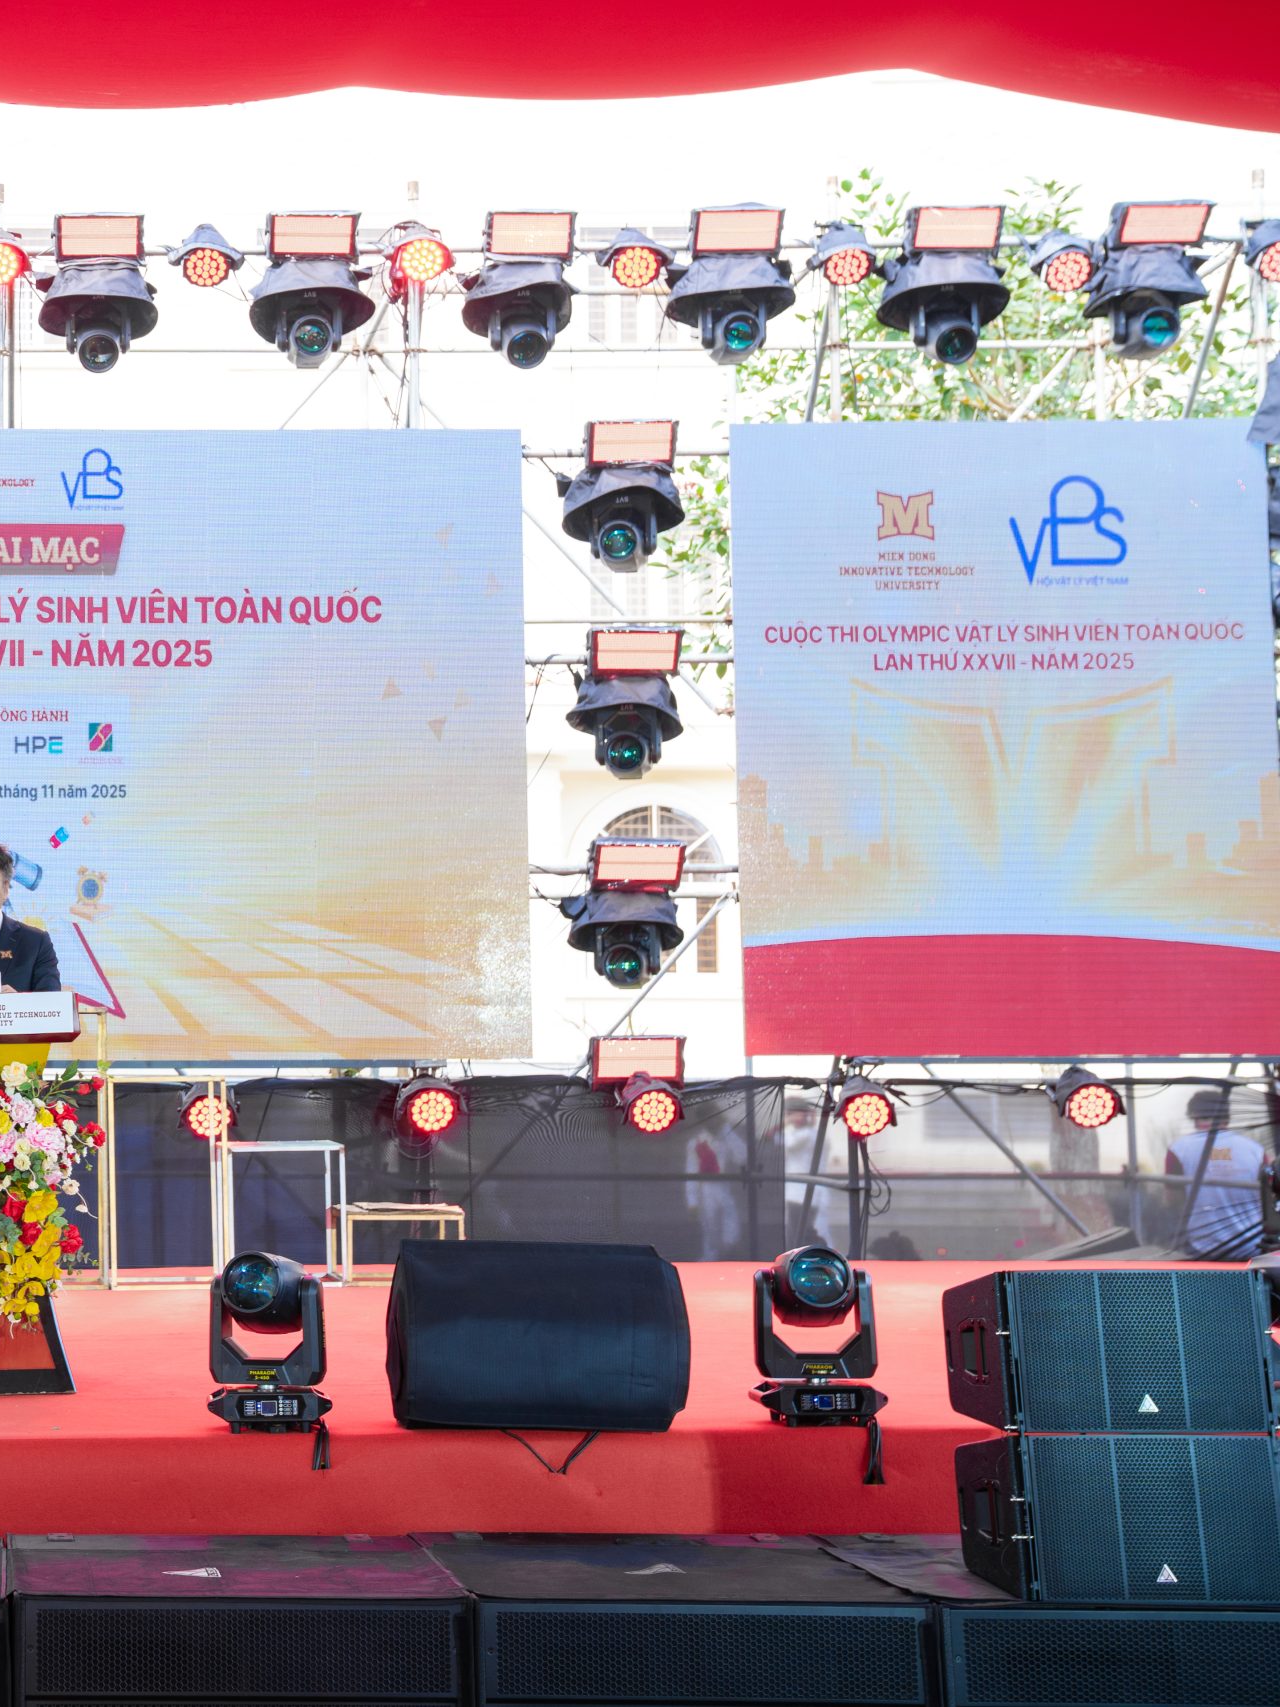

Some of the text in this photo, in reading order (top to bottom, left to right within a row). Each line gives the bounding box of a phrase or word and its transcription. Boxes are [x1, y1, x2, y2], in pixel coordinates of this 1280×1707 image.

[877, 490, 935, 541] M
[29, 536, 101, 571] MẠC
[878, 551, 936, 562] MIEN DONG
[839, 566, 976, 577] INNOVATIVE TECHNOLOGY
[875, 580, 941, 591] UNIVERSITY
[36, 596, 109, 623] SINH
[116, 588, 188, 624] VIÊN
[195, 588, 282, 623] TOÀN
[289, 586, 382, 625] QUỐC
[765, 616, 1244, 648] CUỘC THI OLYMPIC VẬT LÝ SINH VIÊN TOÀN QUỐC
[51, 632, 125, 667] NĂM
[132, 639, 213, 668] 2025
[917, 648, 958, 671] THỨ
[963, 653, 1016, 670] XXVII
[1032, 646, 1078, 670] NĂM
[1083, 652, 1135, 670] 2025
[32, 708, 69, 722] HÀNH
[14, 736, 63, 754] HPE
[42, 785, 54, 798] 11
[58, 785, 87, 799] năm
[91, 785, 127, 799] 2025
[14, 1010, 62, 1019] TECHNOLOGY
